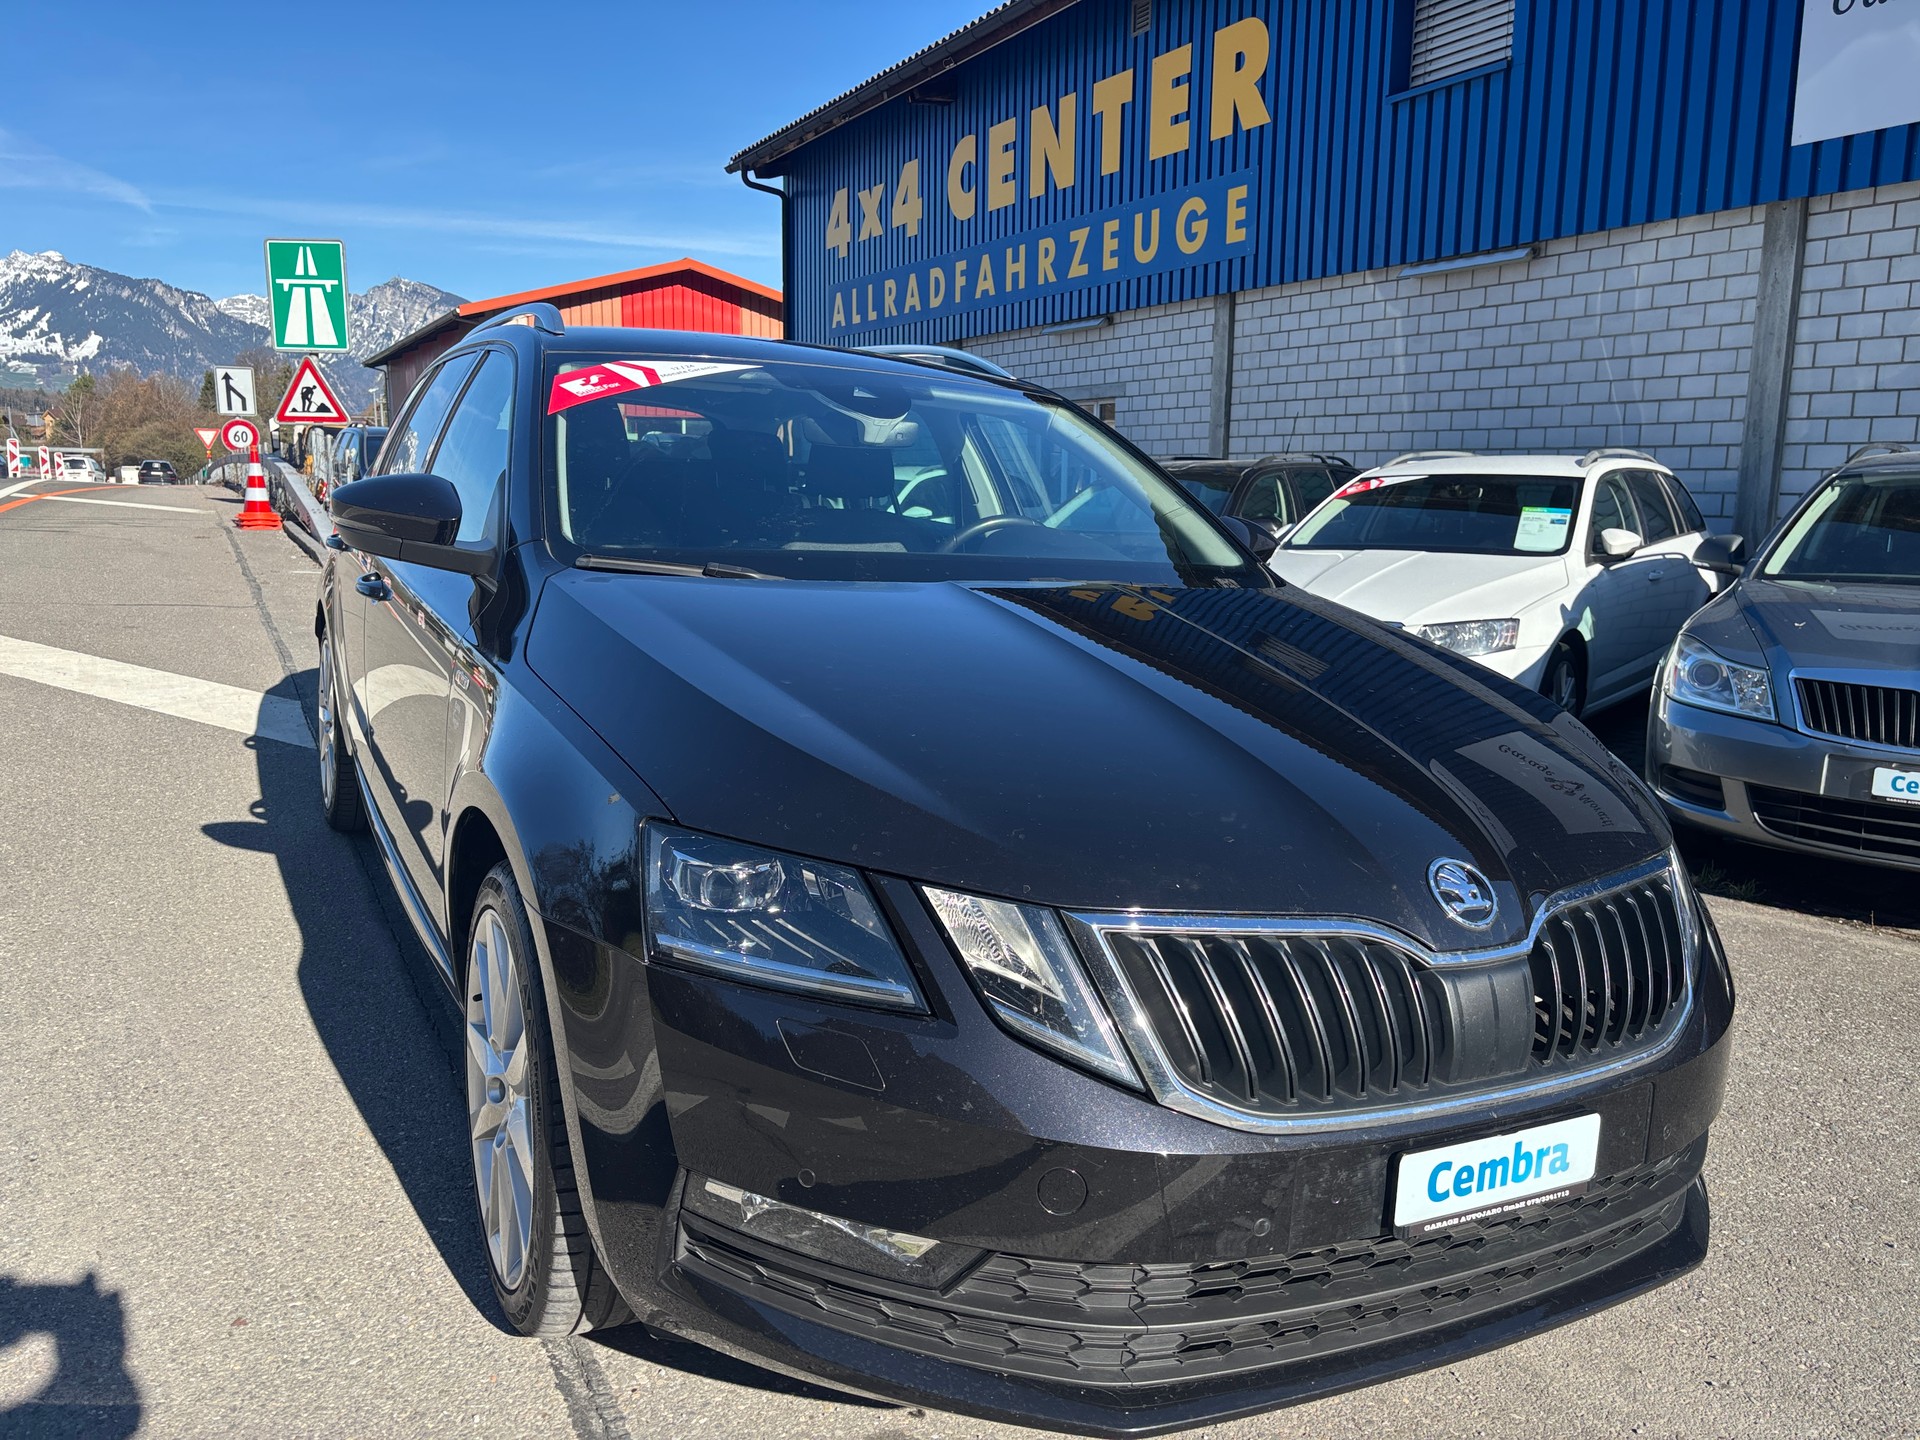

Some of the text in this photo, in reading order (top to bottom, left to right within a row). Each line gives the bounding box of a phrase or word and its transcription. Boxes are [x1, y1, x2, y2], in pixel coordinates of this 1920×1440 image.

[825, 16, 1272, 259] 4x4 CENTER
[831, 184, 1249, 329] ALLRADFAHRZEUGE
[233, 430, 248, 443] 60
[1427, 1140, 1570, 1203] Cembra
[1423, 1217, 1459, 1232] GARAGE
